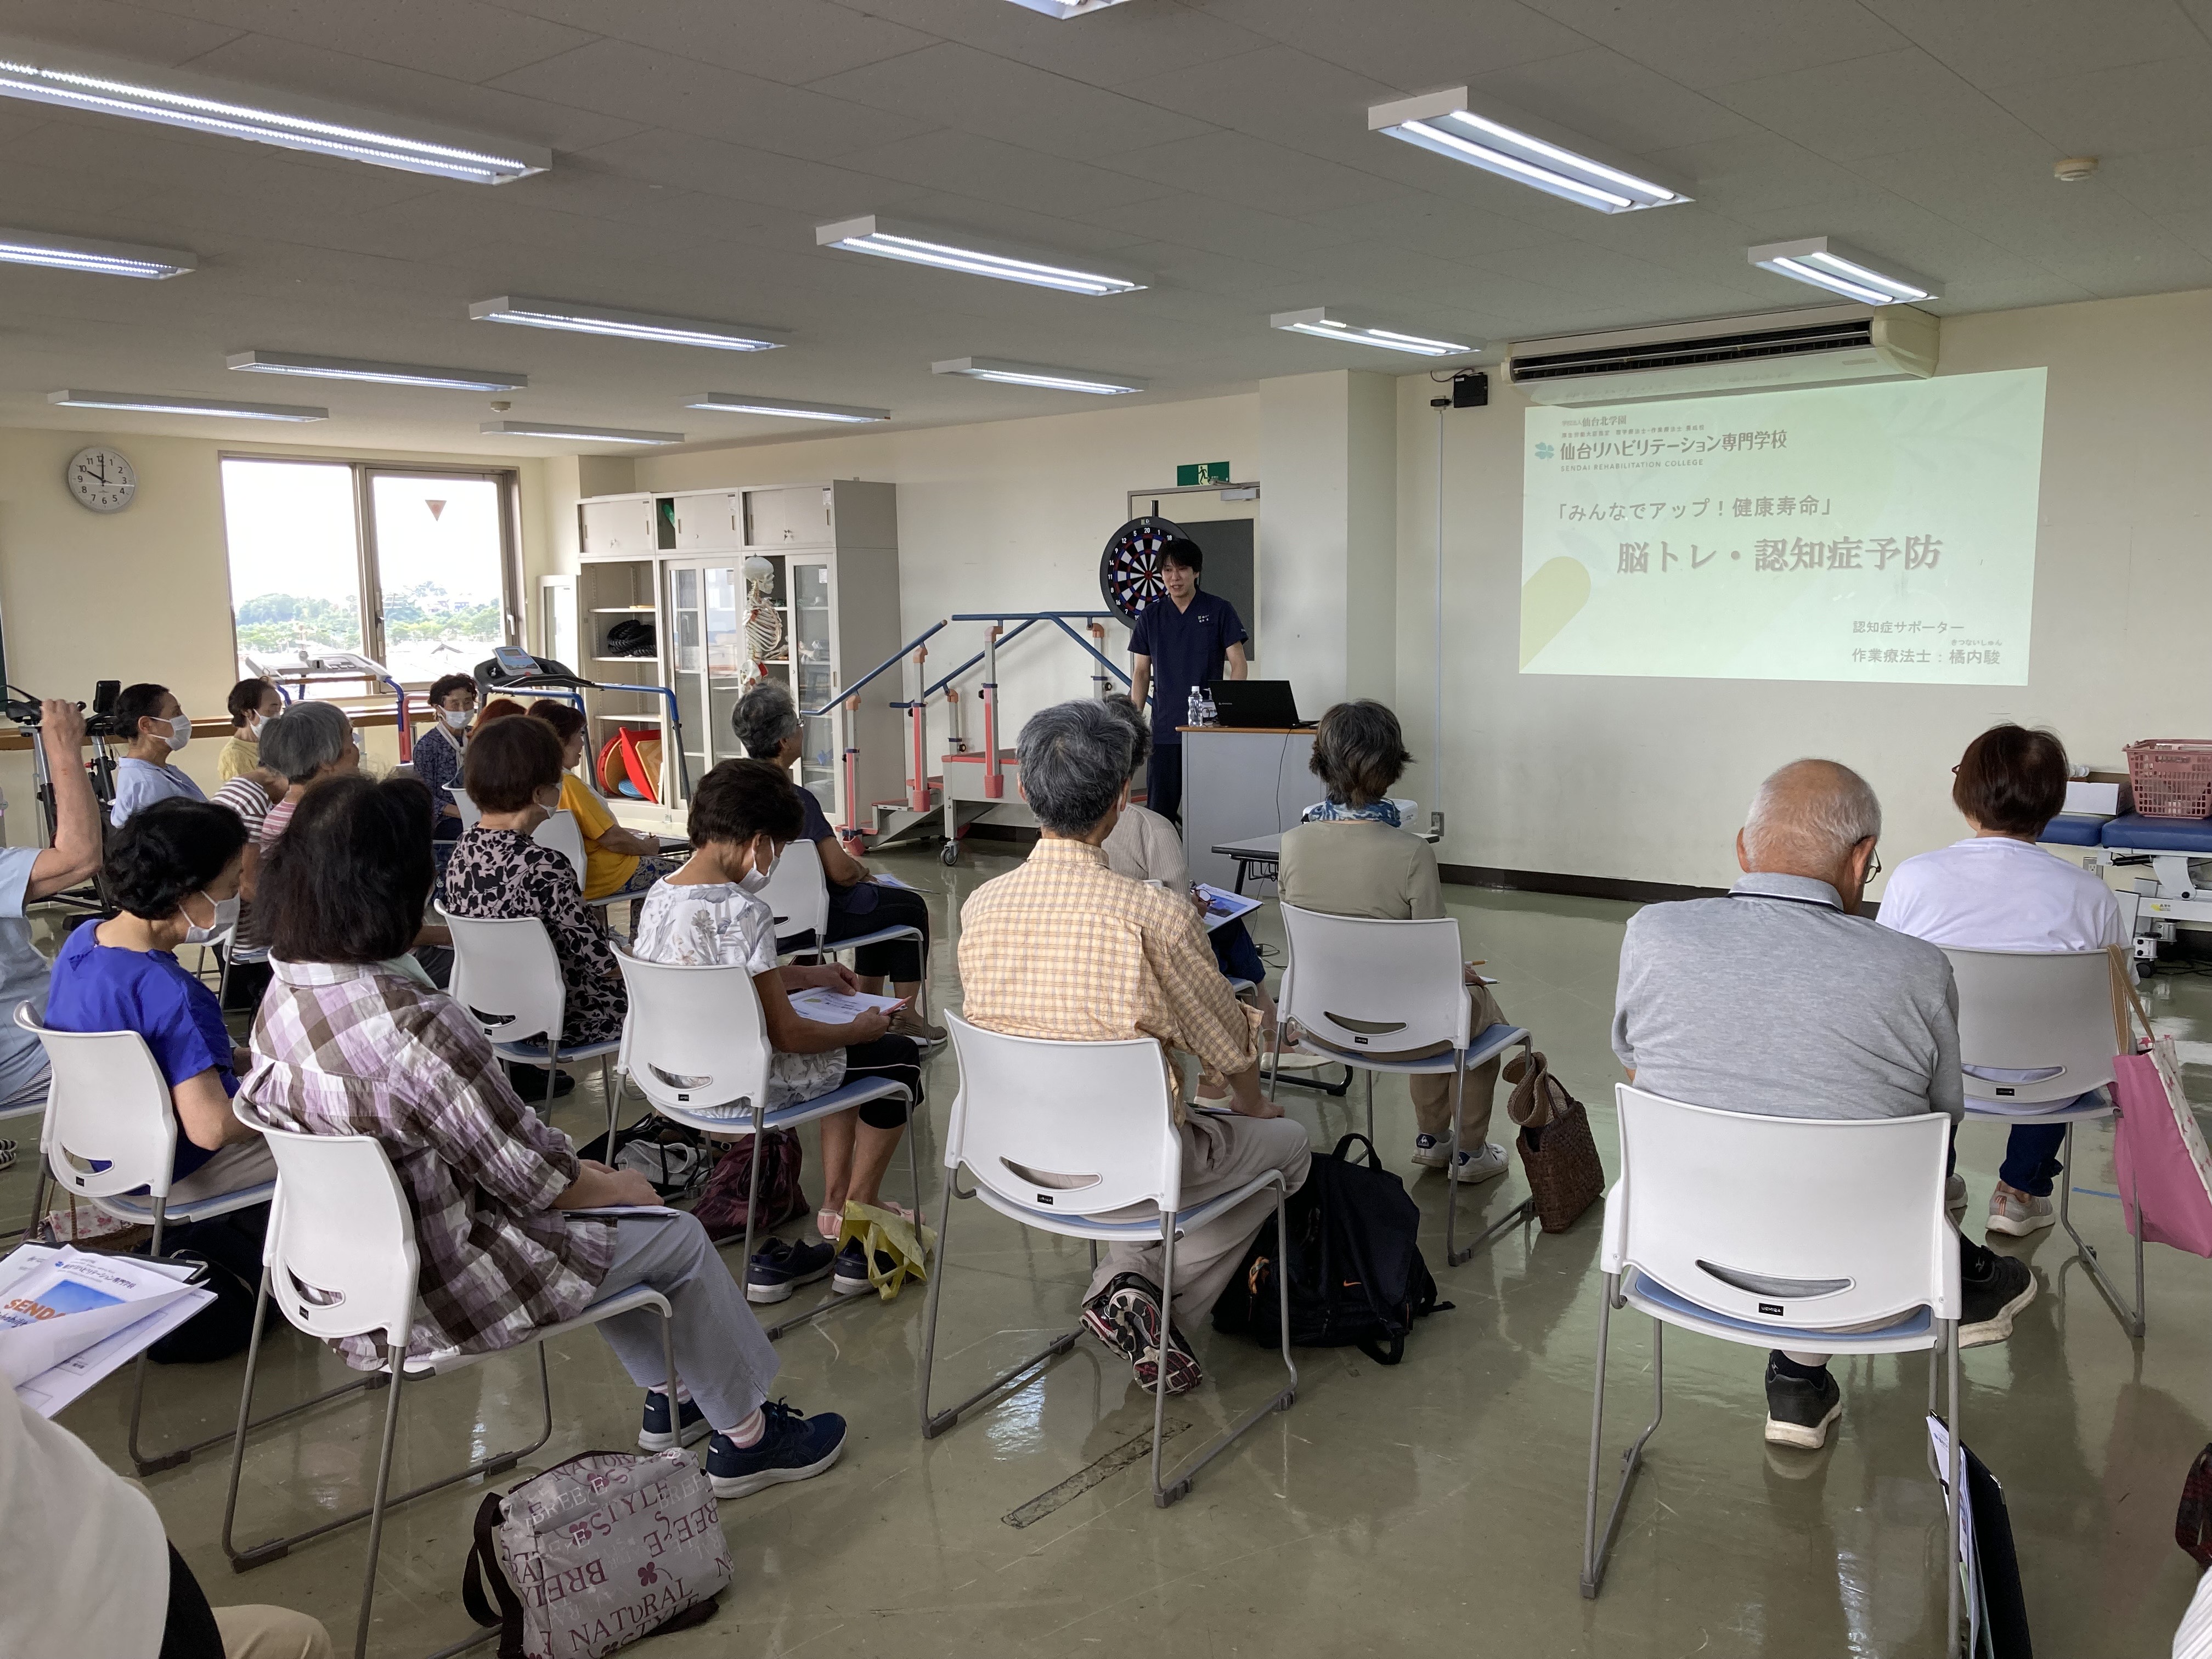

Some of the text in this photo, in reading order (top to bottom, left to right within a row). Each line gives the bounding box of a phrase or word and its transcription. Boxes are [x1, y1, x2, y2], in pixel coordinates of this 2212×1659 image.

[1560, 429, 1787, 460] 仙台リハビリテーション専門学校
[1594, 461, 1661, 471] REHABILITATION
[1664, 459, 1703, 467] COLLEGE
[1560, 494, 1830, 521] 「みんなでアップ！健康寿命」
[1617, 534, 1943, 574] 脳トレ・認知症予防
[1853, 620, 1965, 634] 認知症サポーター
[567, 1577, 693, 1653] NATURAL
